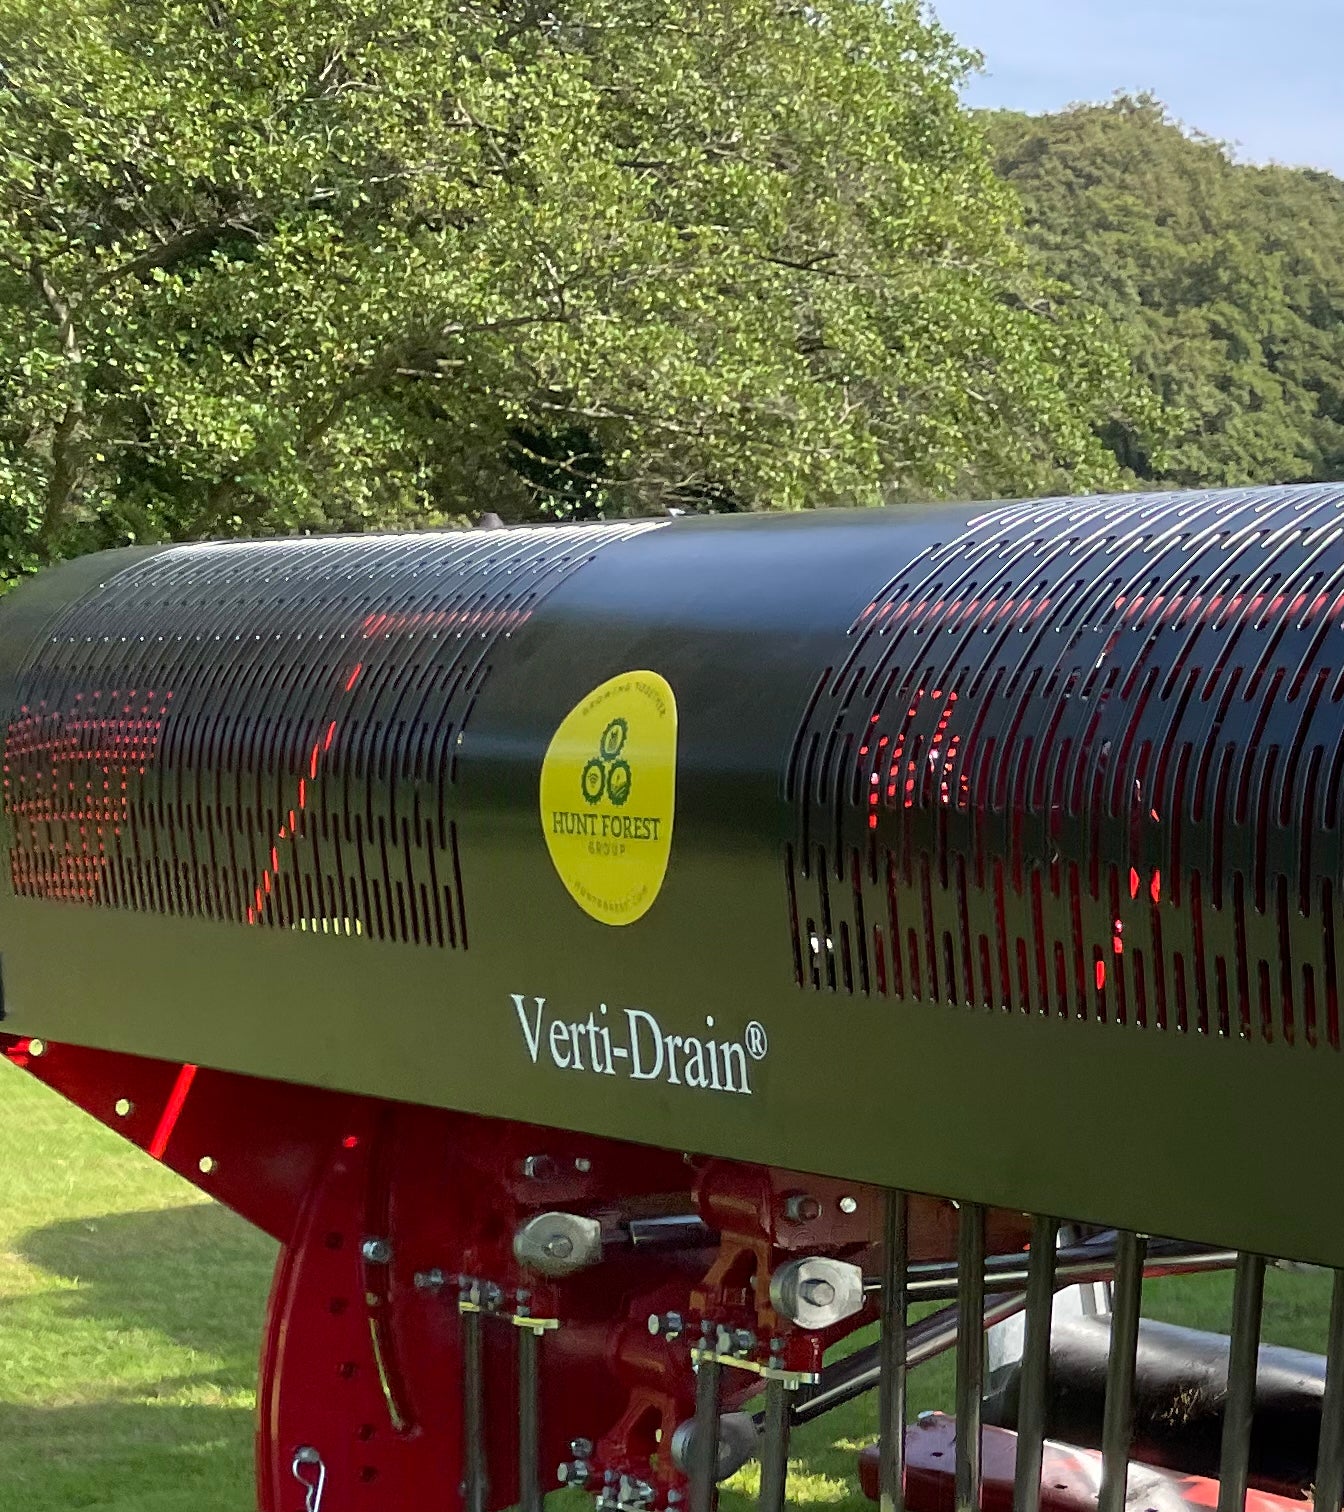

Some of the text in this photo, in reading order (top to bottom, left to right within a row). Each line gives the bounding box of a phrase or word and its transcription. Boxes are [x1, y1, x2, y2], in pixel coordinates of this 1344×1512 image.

[553, 811, 661, 841] HUNT FOREST
[587, 841, 627, 857] GROUP
[509, 992, 768, 1095] Verti-Drain®
